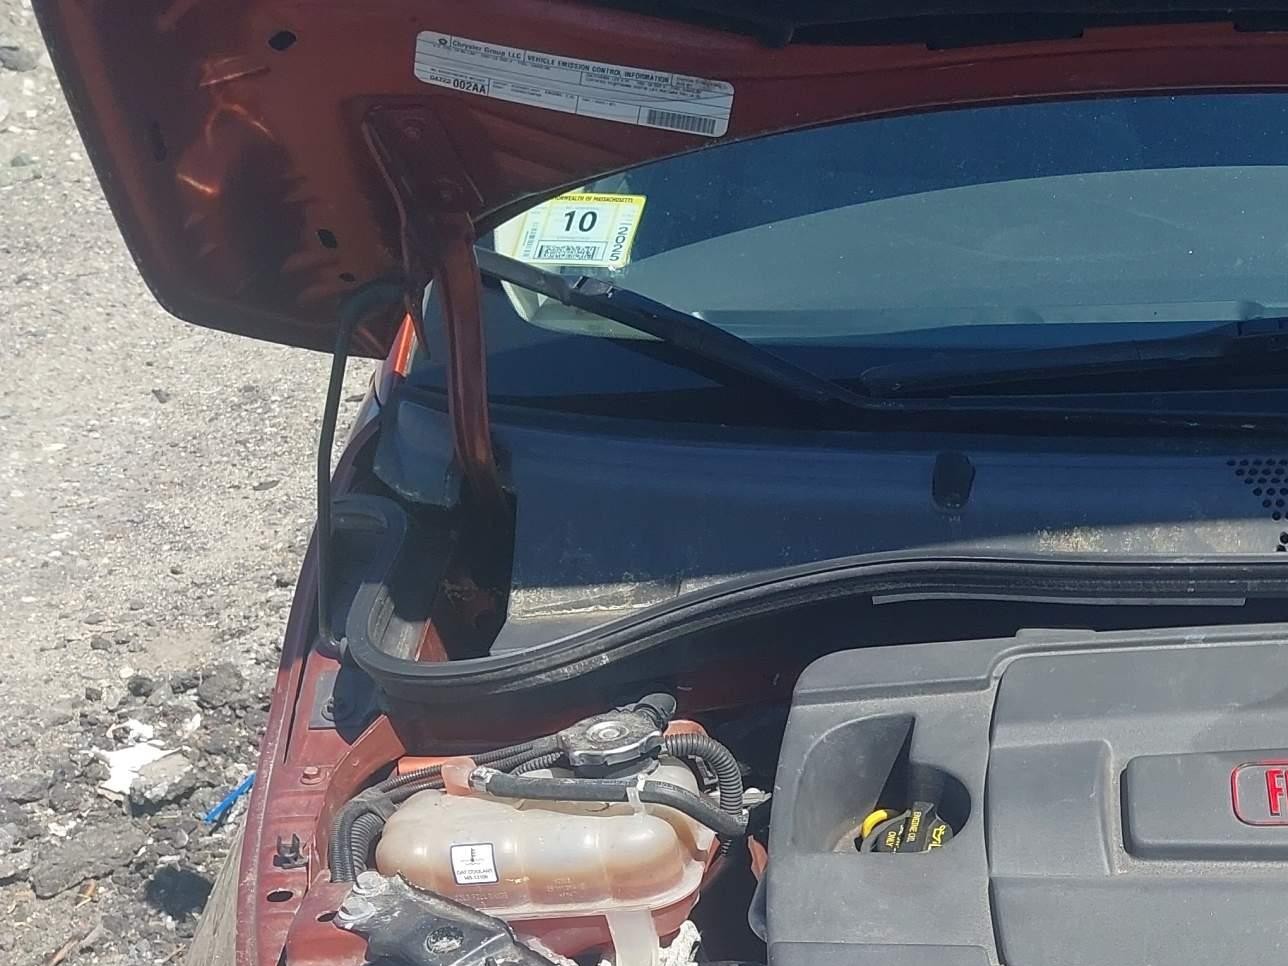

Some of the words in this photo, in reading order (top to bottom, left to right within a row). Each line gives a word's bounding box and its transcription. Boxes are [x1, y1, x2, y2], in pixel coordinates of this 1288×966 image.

[527, 55, 555, 66] VEHICLE
[558, 60, 591, 72] EMISSION
[592, 65, 621, 77] CONTROL
[624, 69, 670, 84] INFORMATION
[453, 79, 487, 95] 002AA
[564, 209, 598, 233] 10
[608, 226, 629, 262] 2025
[909, 811, 922, 833] ENGINE
[886, 831, 897, 849] ONLY
